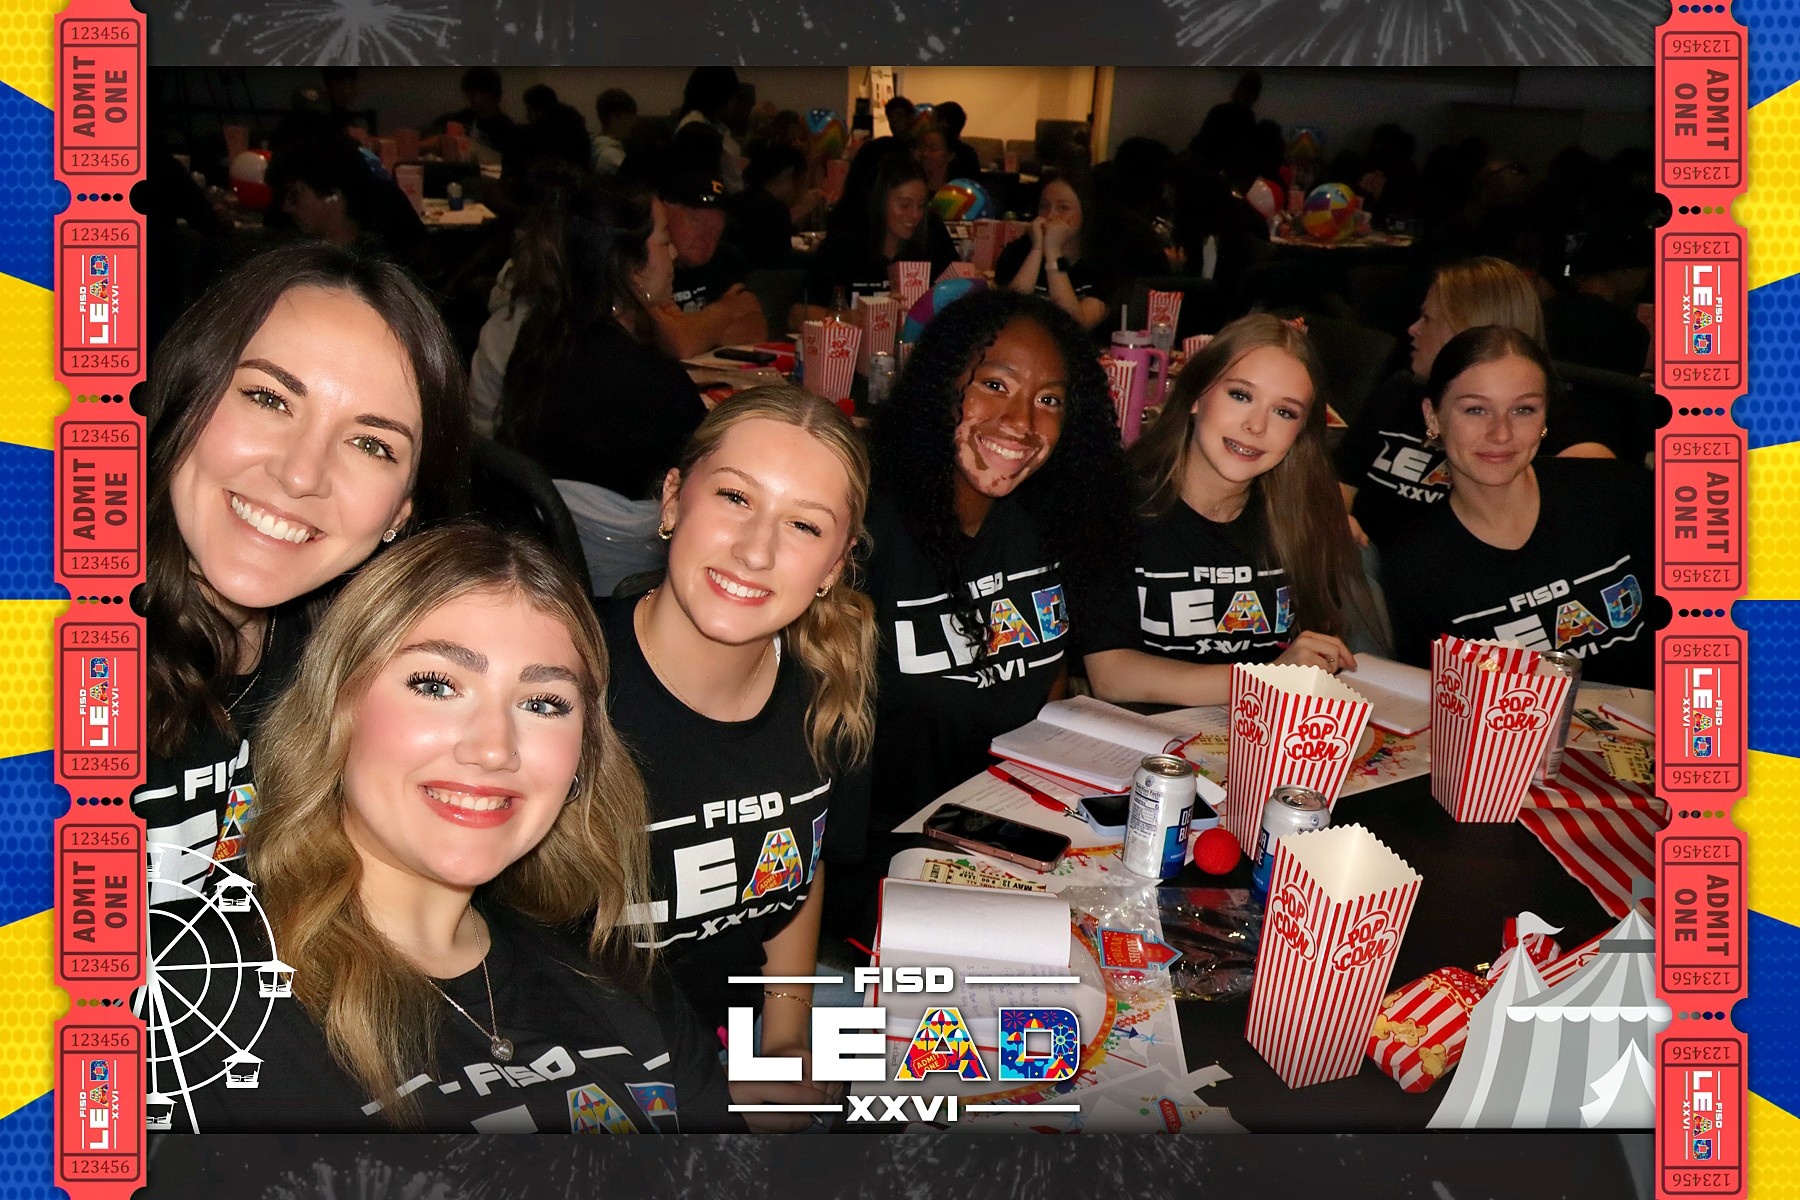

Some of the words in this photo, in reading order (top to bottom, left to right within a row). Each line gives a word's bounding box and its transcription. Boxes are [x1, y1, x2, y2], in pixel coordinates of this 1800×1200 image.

[830, 349, 849, 359] CORN
[966, 572, 1003, 600] ISD
[1193, 566, 1252, 584] FISD
[1509, 579, 1570, 613] FISD
[1494, 575, 1643, 651] EAD
[1195, 638, 1251, 654] XXVI
[1441, 674, 1461, 693] POP
[1240, 699, 1259, 720] POP
[1439, 692, 1465, 717] CORN
[1499, 696, 1534, 714] POP
[1237, 719, 1264, 746] CORN
[1298, 722, 1334, 741] POP
[1493, 712, 1540, 731] CORN
[1292, 741, 1340, 761] CORN
[703, 791, 784, 829] FISD
[1014, 882, 1033, 891] MAY
[1282, 888, 1305, 922] POP
[1275, 912, 1309, 956] CORN
[1348, 919, 1385, 948] POP
[1127, 938, 1141, 963] SHOW
[1338, 939, 1389, 971] CORN
[464, 1046, 576, 1096] FISD
